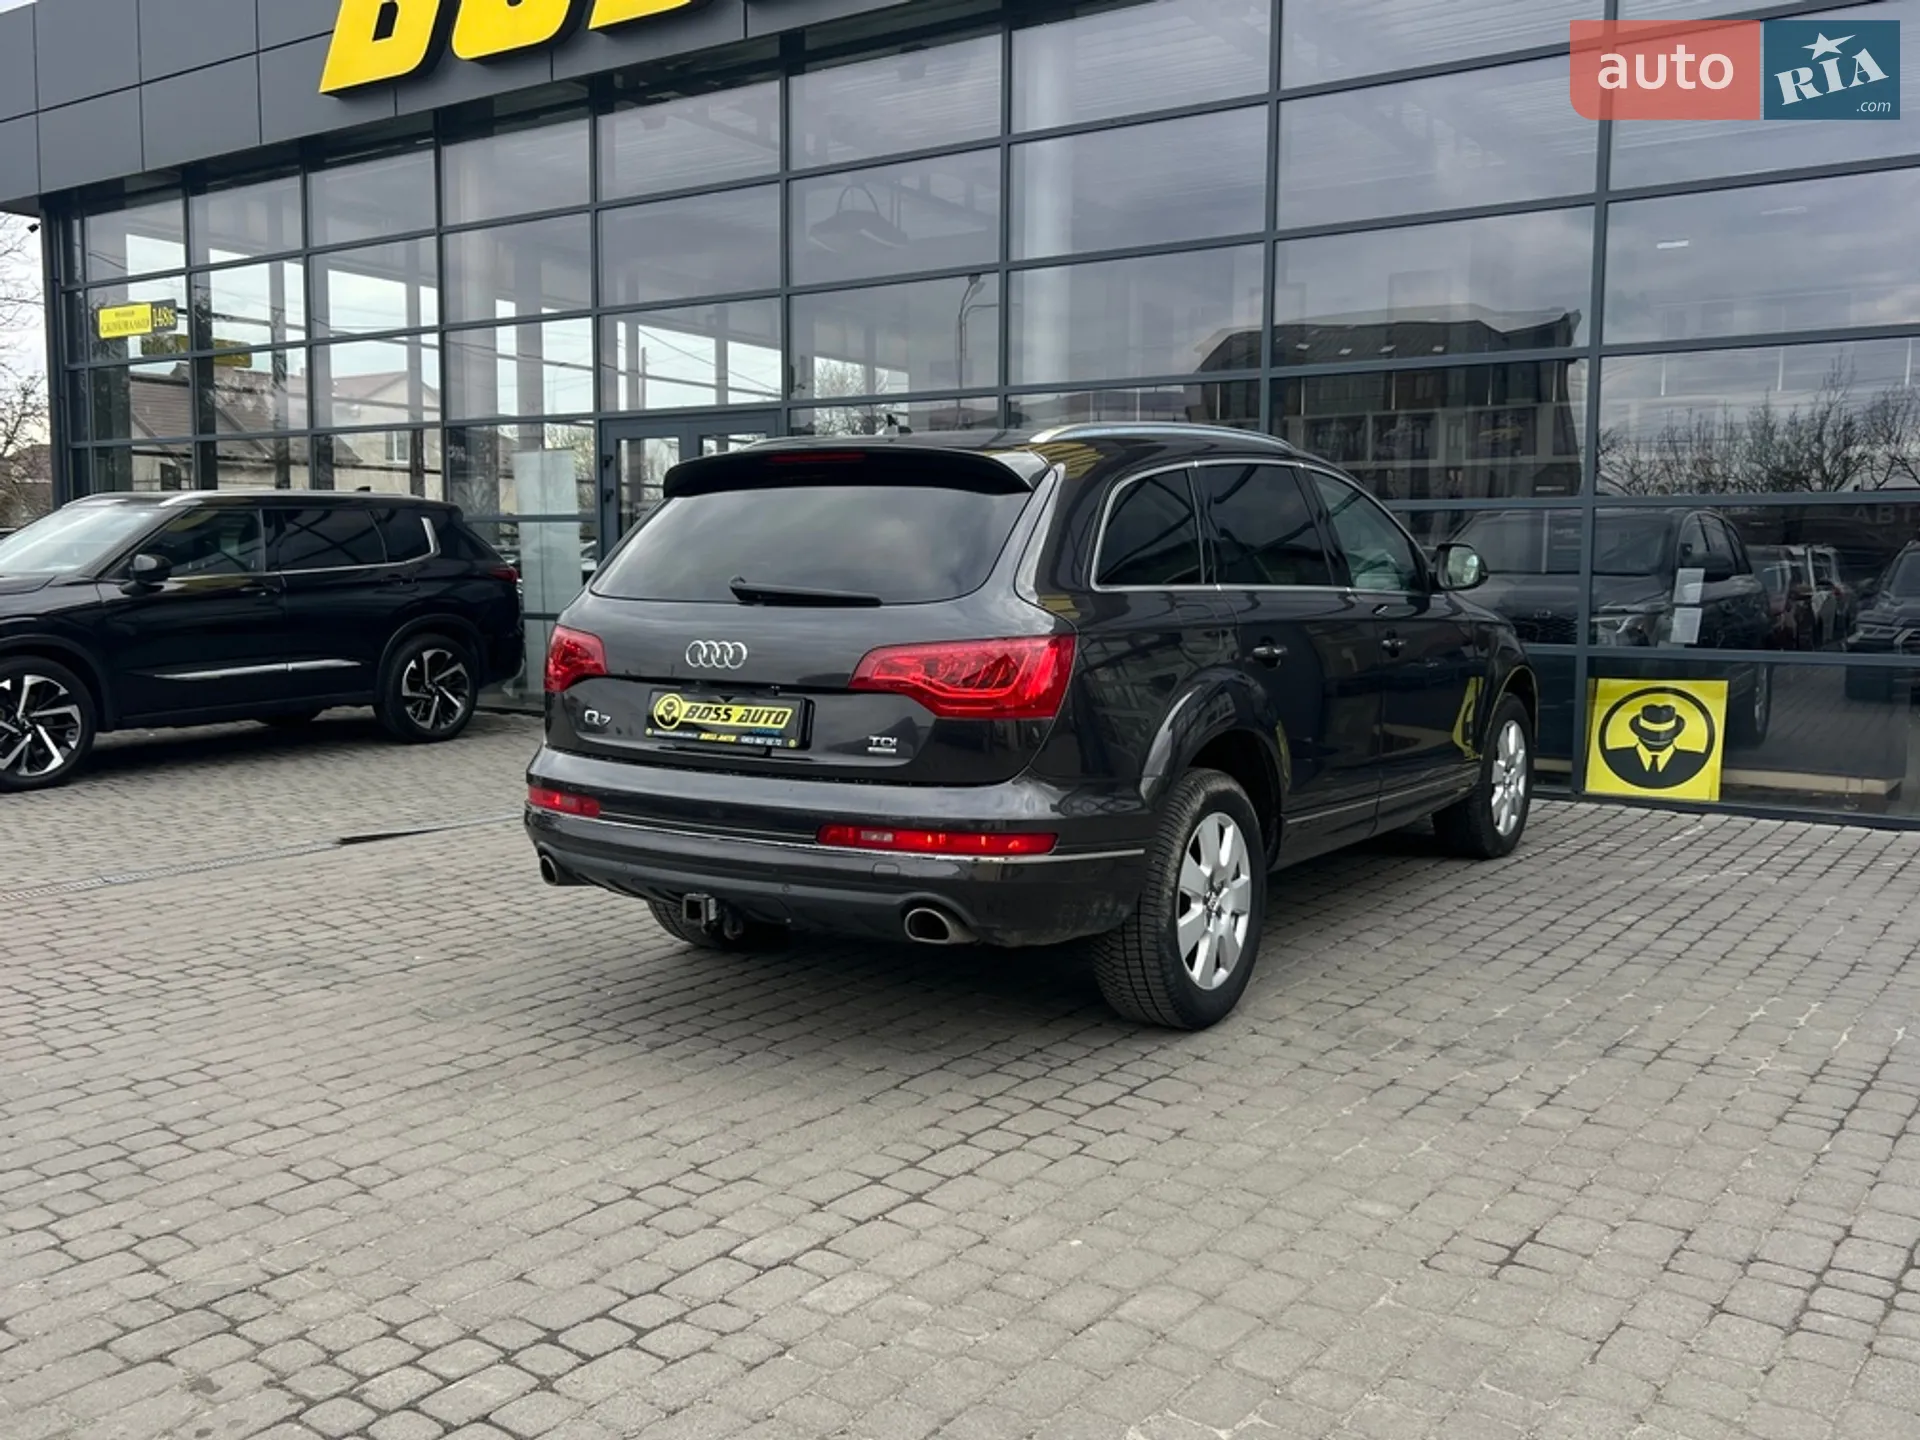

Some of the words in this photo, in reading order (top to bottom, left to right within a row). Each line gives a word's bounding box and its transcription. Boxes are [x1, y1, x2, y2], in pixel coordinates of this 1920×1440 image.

[584, 710, 611, 726] Q7
[683, 704, 733, 722] BOSS
[735, 708, 789, 725] AUTO
